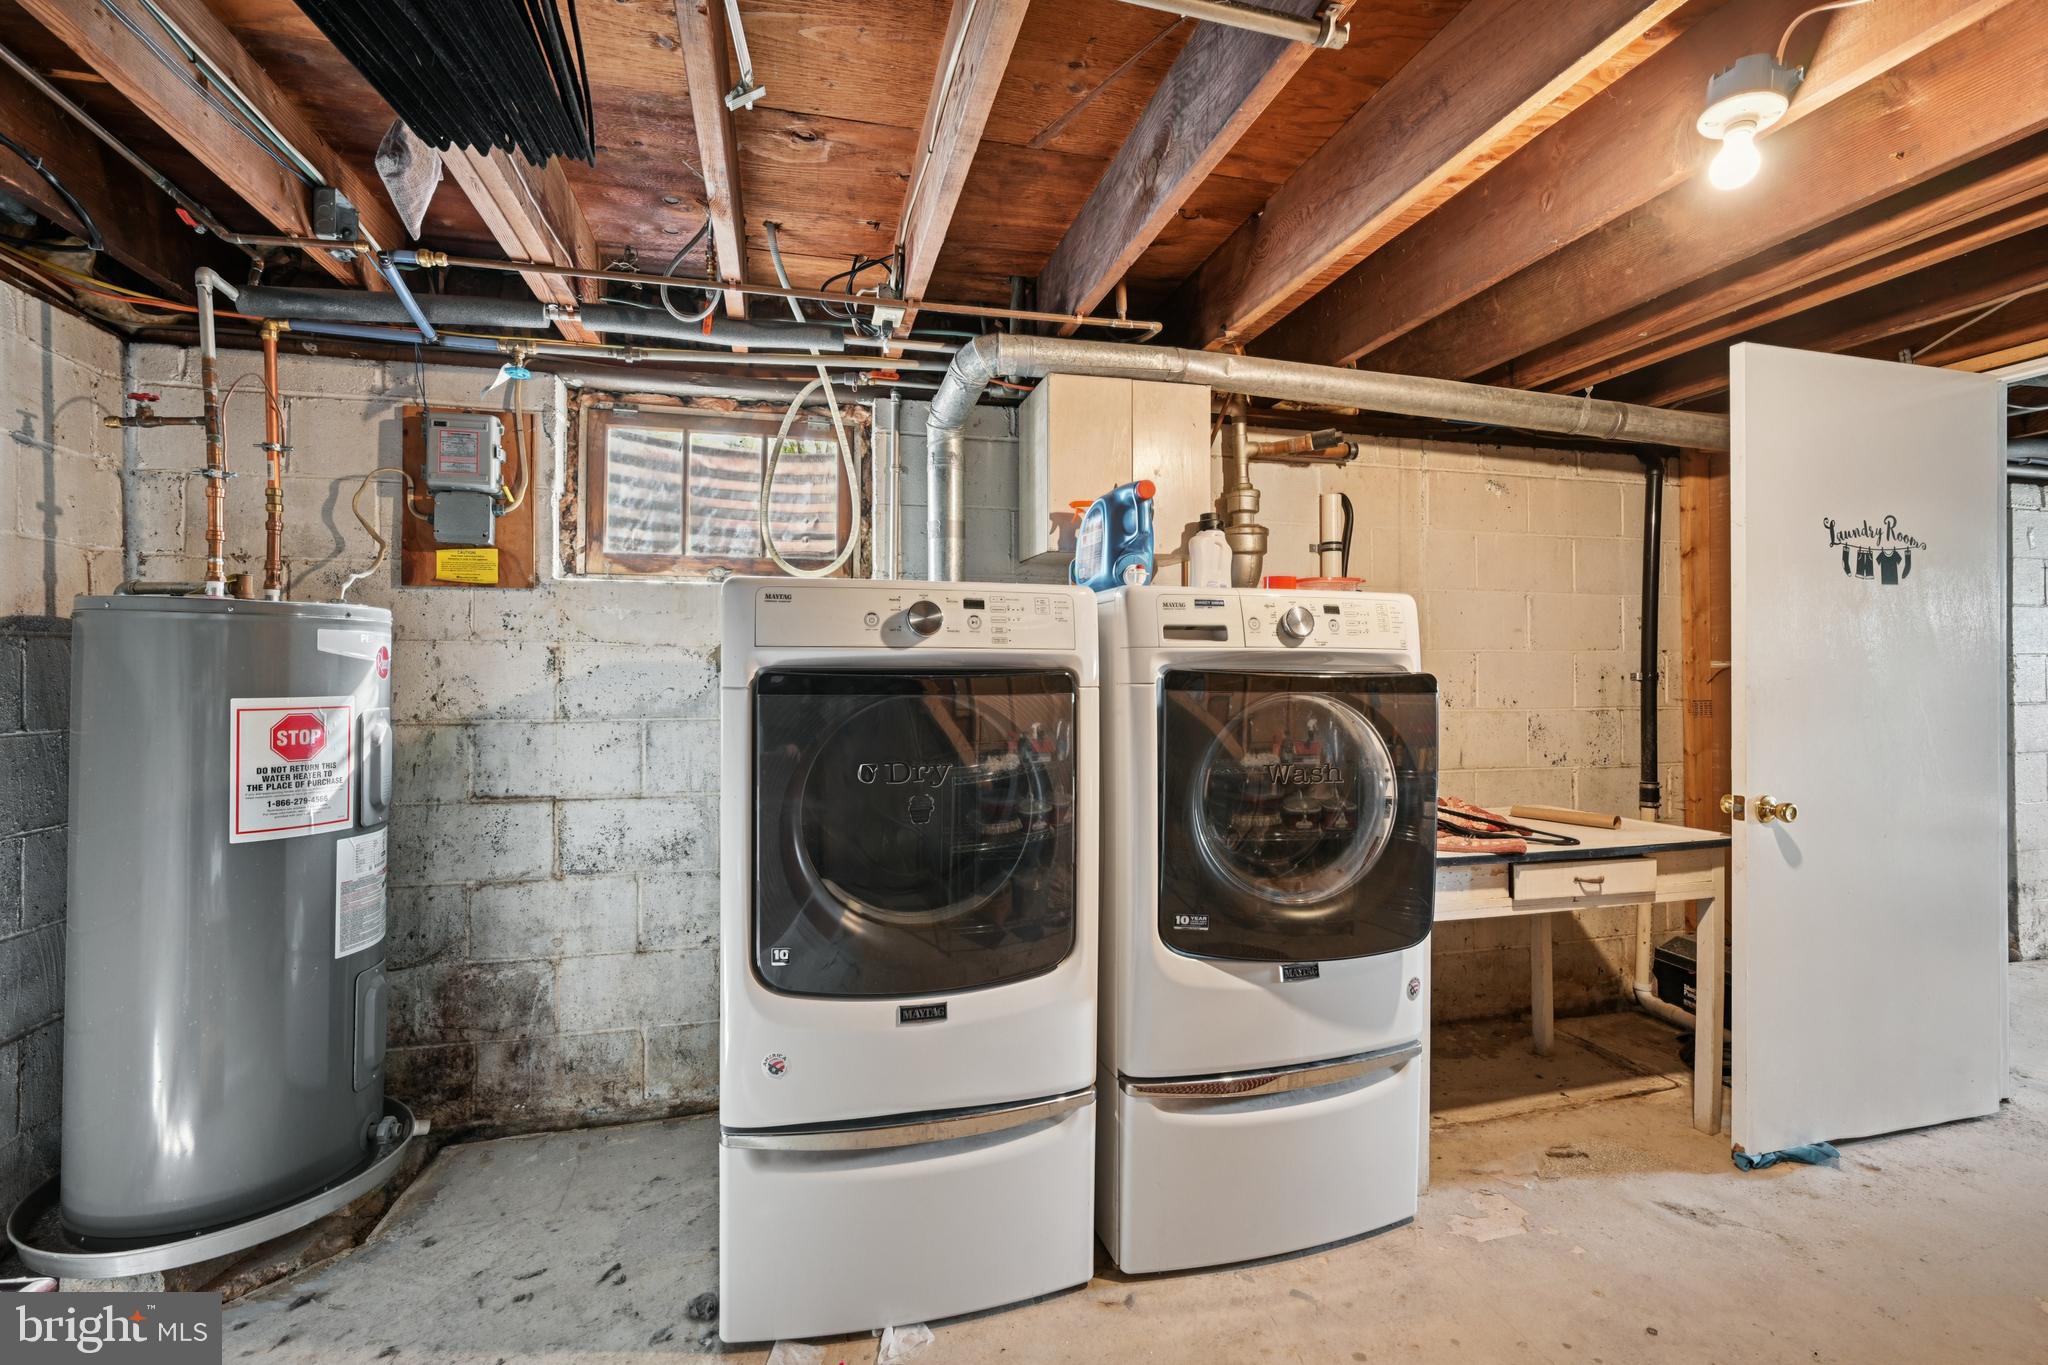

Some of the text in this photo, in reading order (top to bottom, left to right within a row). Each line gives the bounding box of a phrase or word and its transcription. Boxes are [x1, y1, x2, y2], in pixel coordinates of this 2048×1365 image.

[1823, 514, 1927, 551] Laundry Room
[276, 729, 321, 747] STOP
[256, 761, 337, 775] DO NOT RETURN THIS
[1263, 763, 1345, 785] Wash
[262, 773, 291, 782] WATER
[293, 771, 322, 780] HEATER
[884, 763, 953, 788] Dry
[246, 784, 264, 792] THE
[266, 782, 293, 791] PLACE
[307, 776, 343, 788] PURCHASE
[1175, 915, 1190, 925] 10
[773, 949, 790, 960] 10
[1284, 966, 1319, 978] MAYTAG
[902, 1007, 945, 1020] MAYTAG
